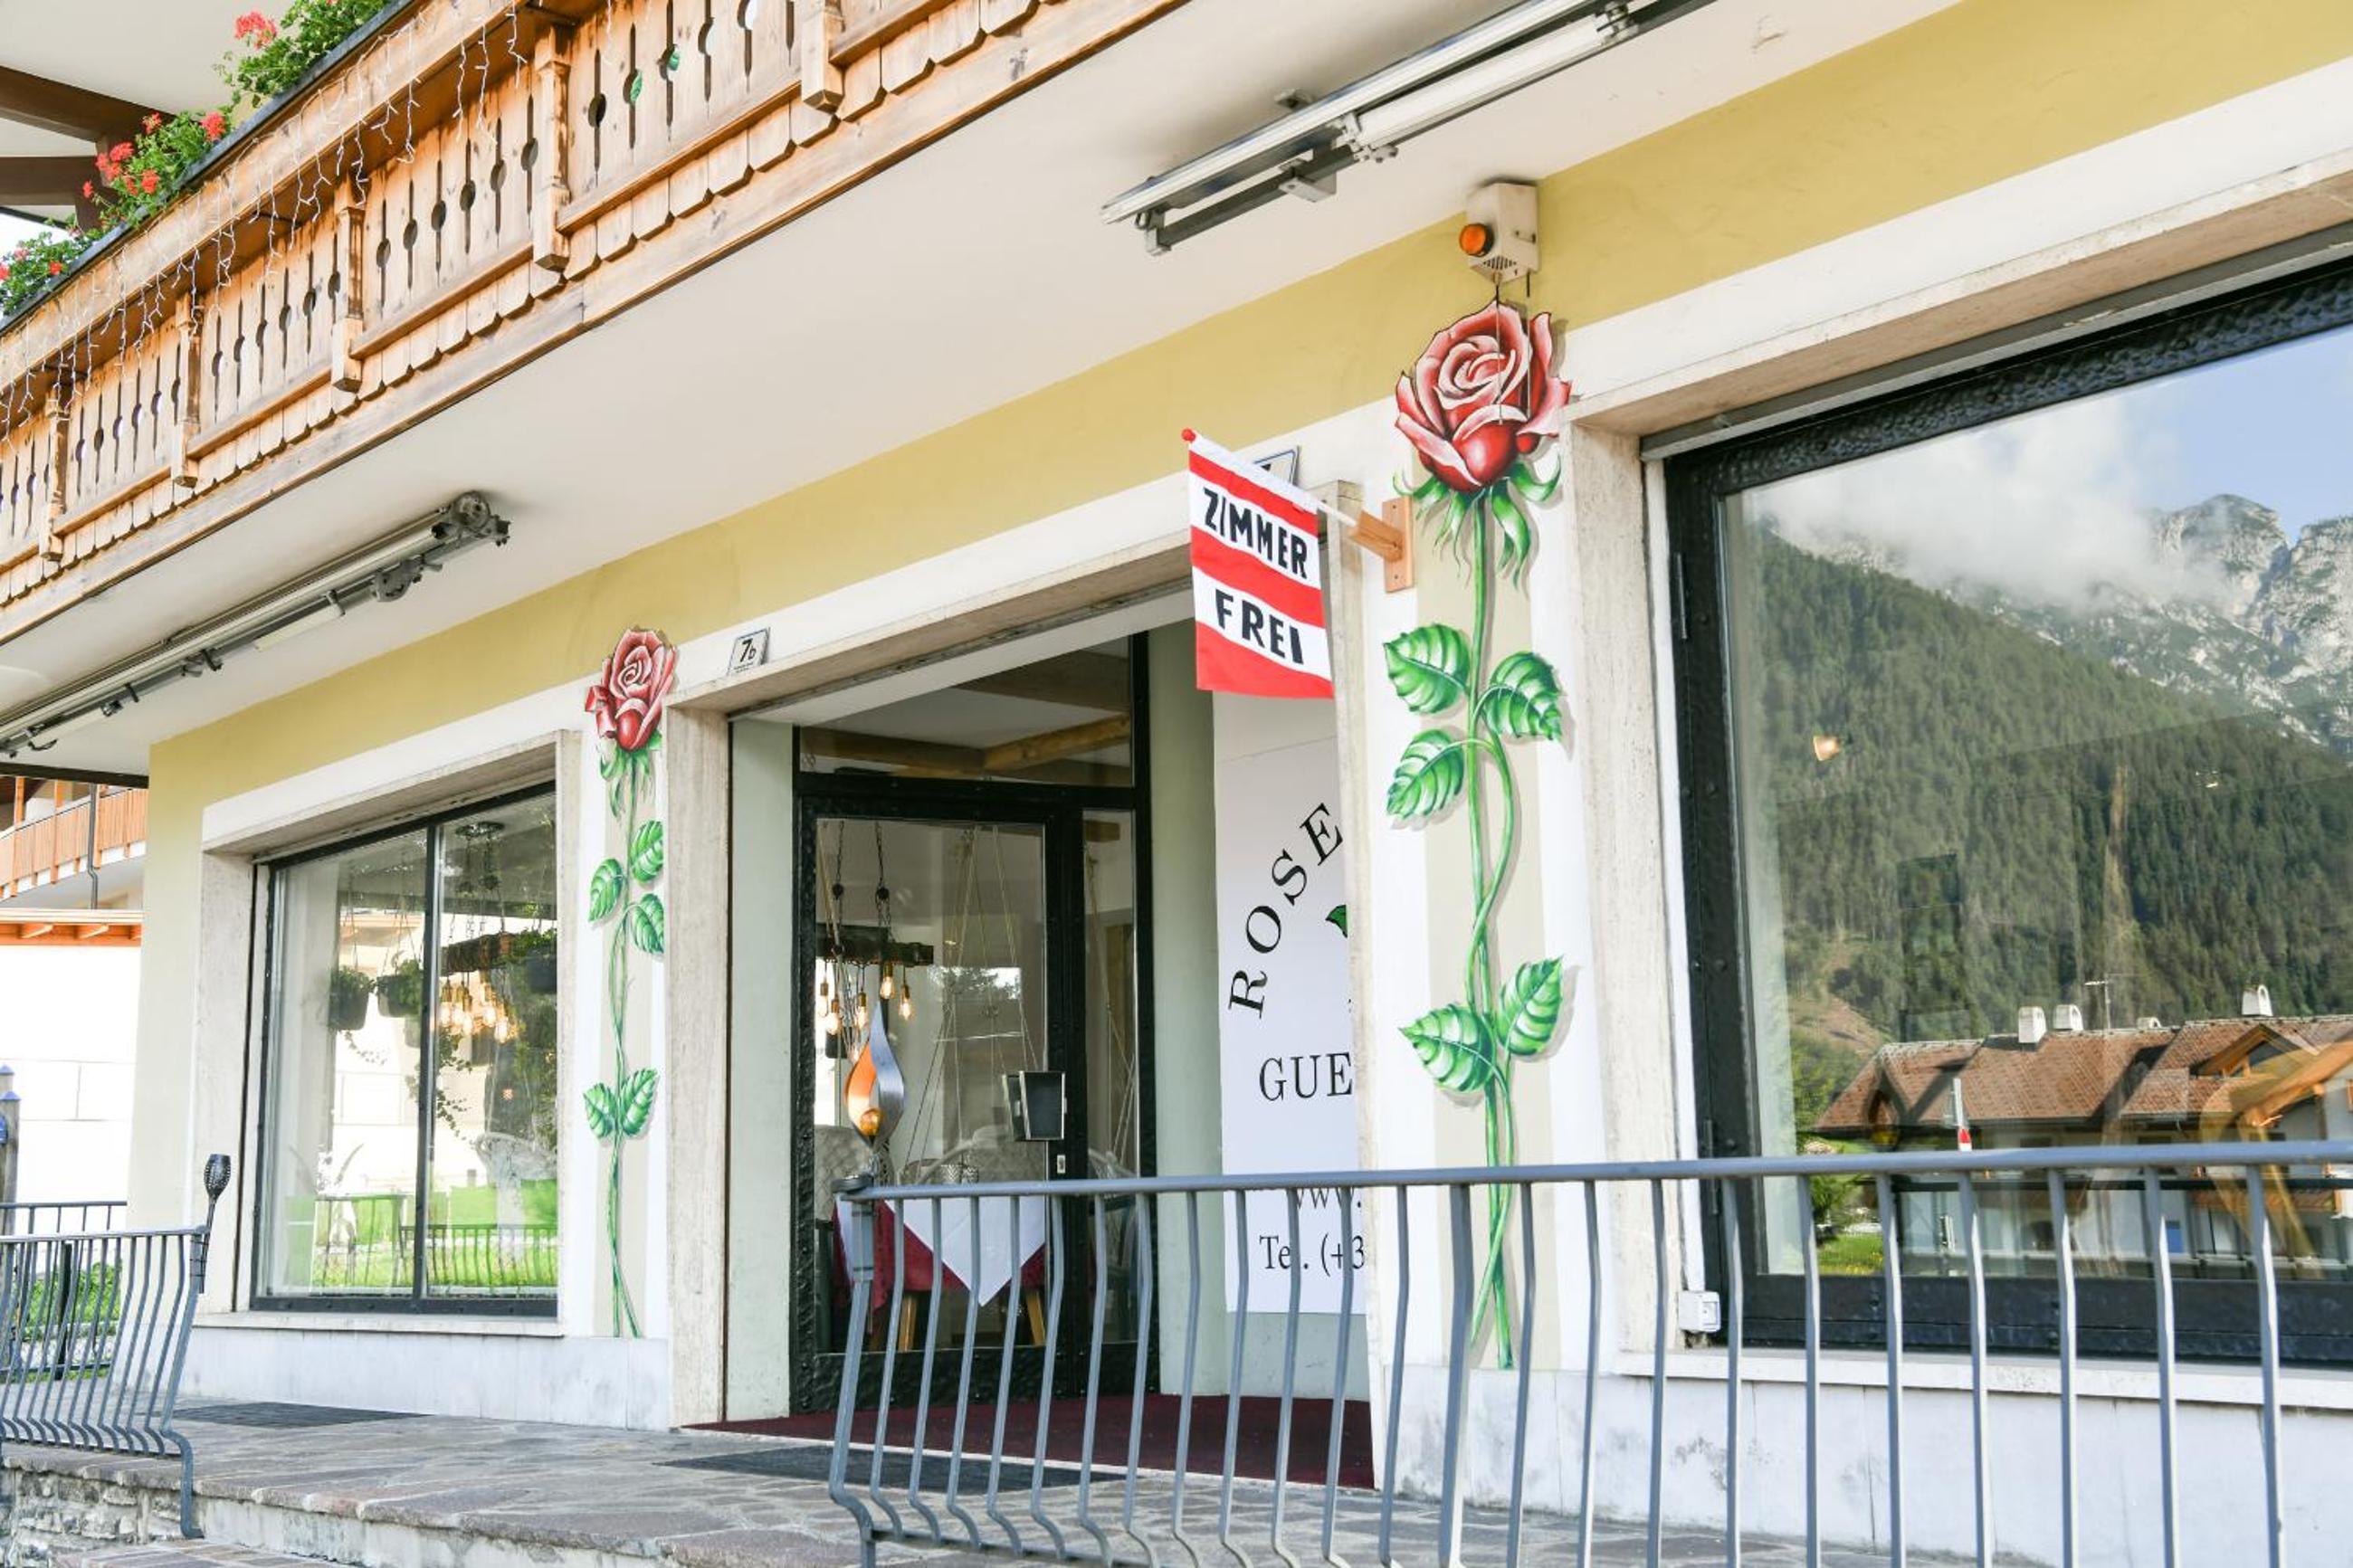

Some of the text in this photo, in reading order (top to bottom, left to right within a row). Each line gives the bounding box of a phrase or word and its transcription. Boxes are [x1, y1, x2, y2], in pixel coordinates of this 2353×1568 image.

[1203, 488, 1308, 579] ZIMMER
[1215, 588, 1304, 665] FREI
[1227, 803, 1344, 1020] ROSE
[1259, 1234, 1309, 1269] Te.
